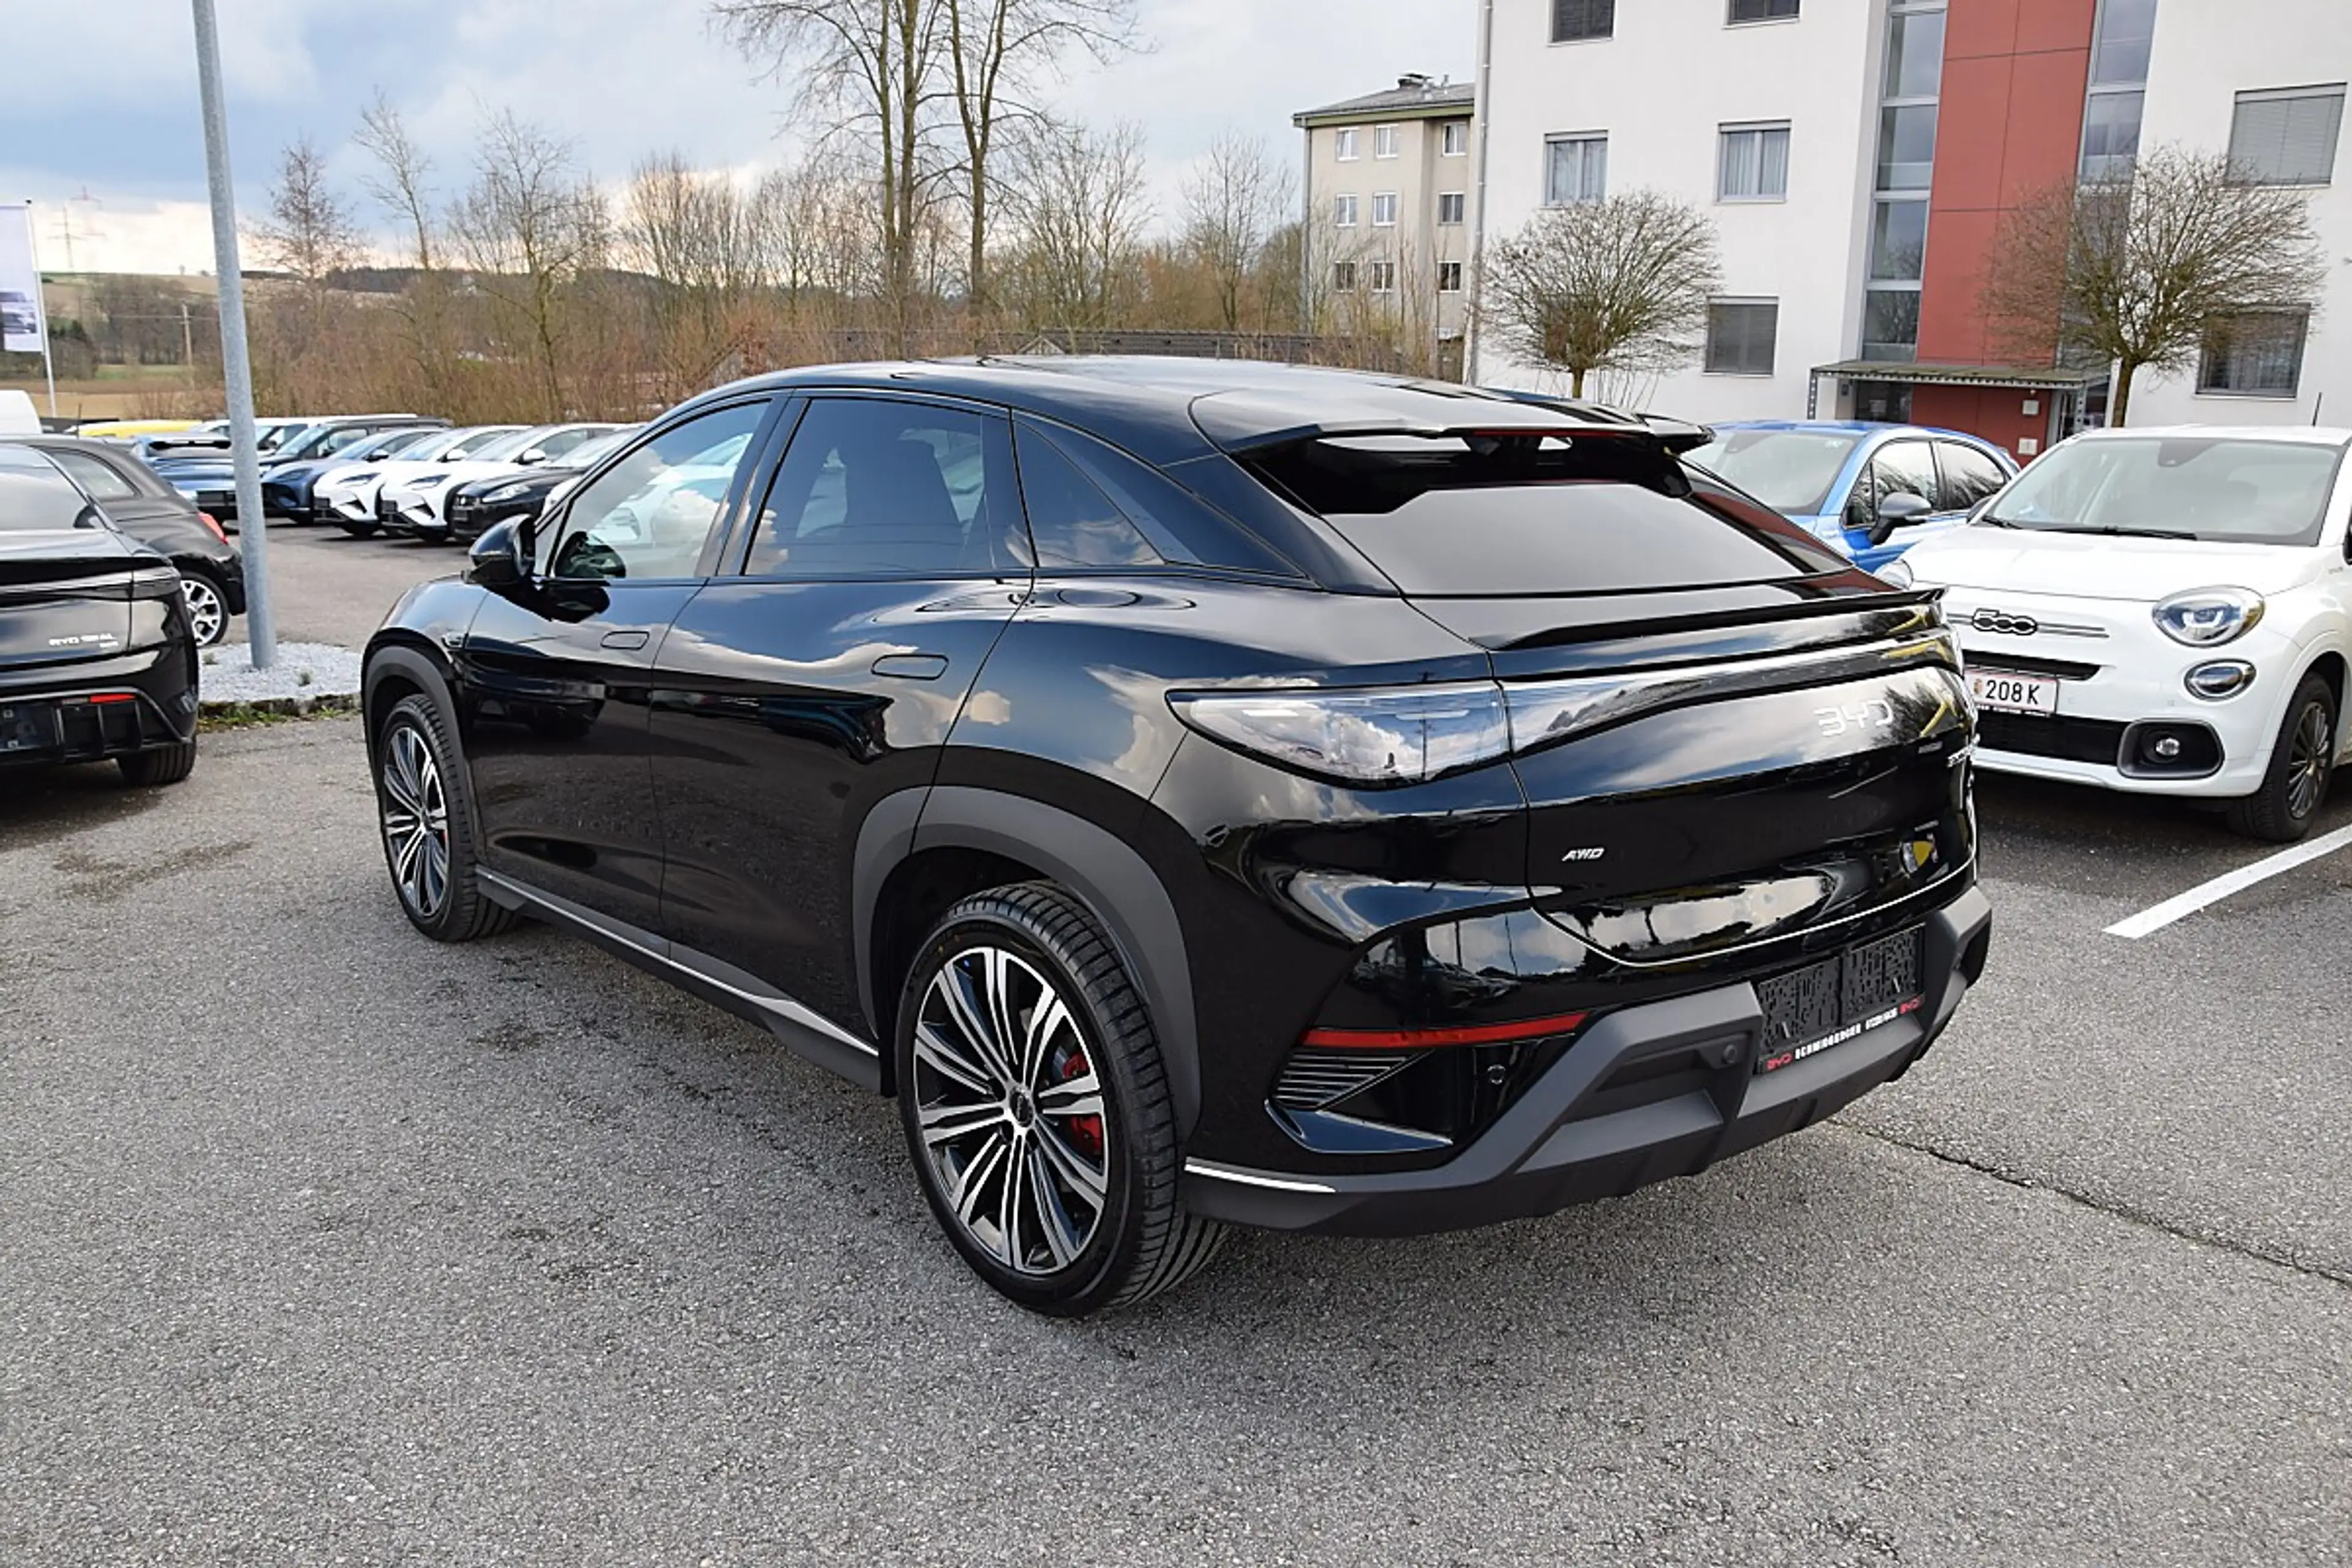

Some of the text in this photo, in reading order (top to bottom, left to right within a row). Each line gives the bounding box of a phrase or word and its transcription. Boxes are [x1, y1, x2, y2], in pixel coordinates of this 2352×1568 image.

[1972, 607, 2038, 636] 500
[1985, 680, 2040, 705] 208 K
[1814, 699, 1894, 737] BYD
[1561, 846, 1605, 862] AWD
